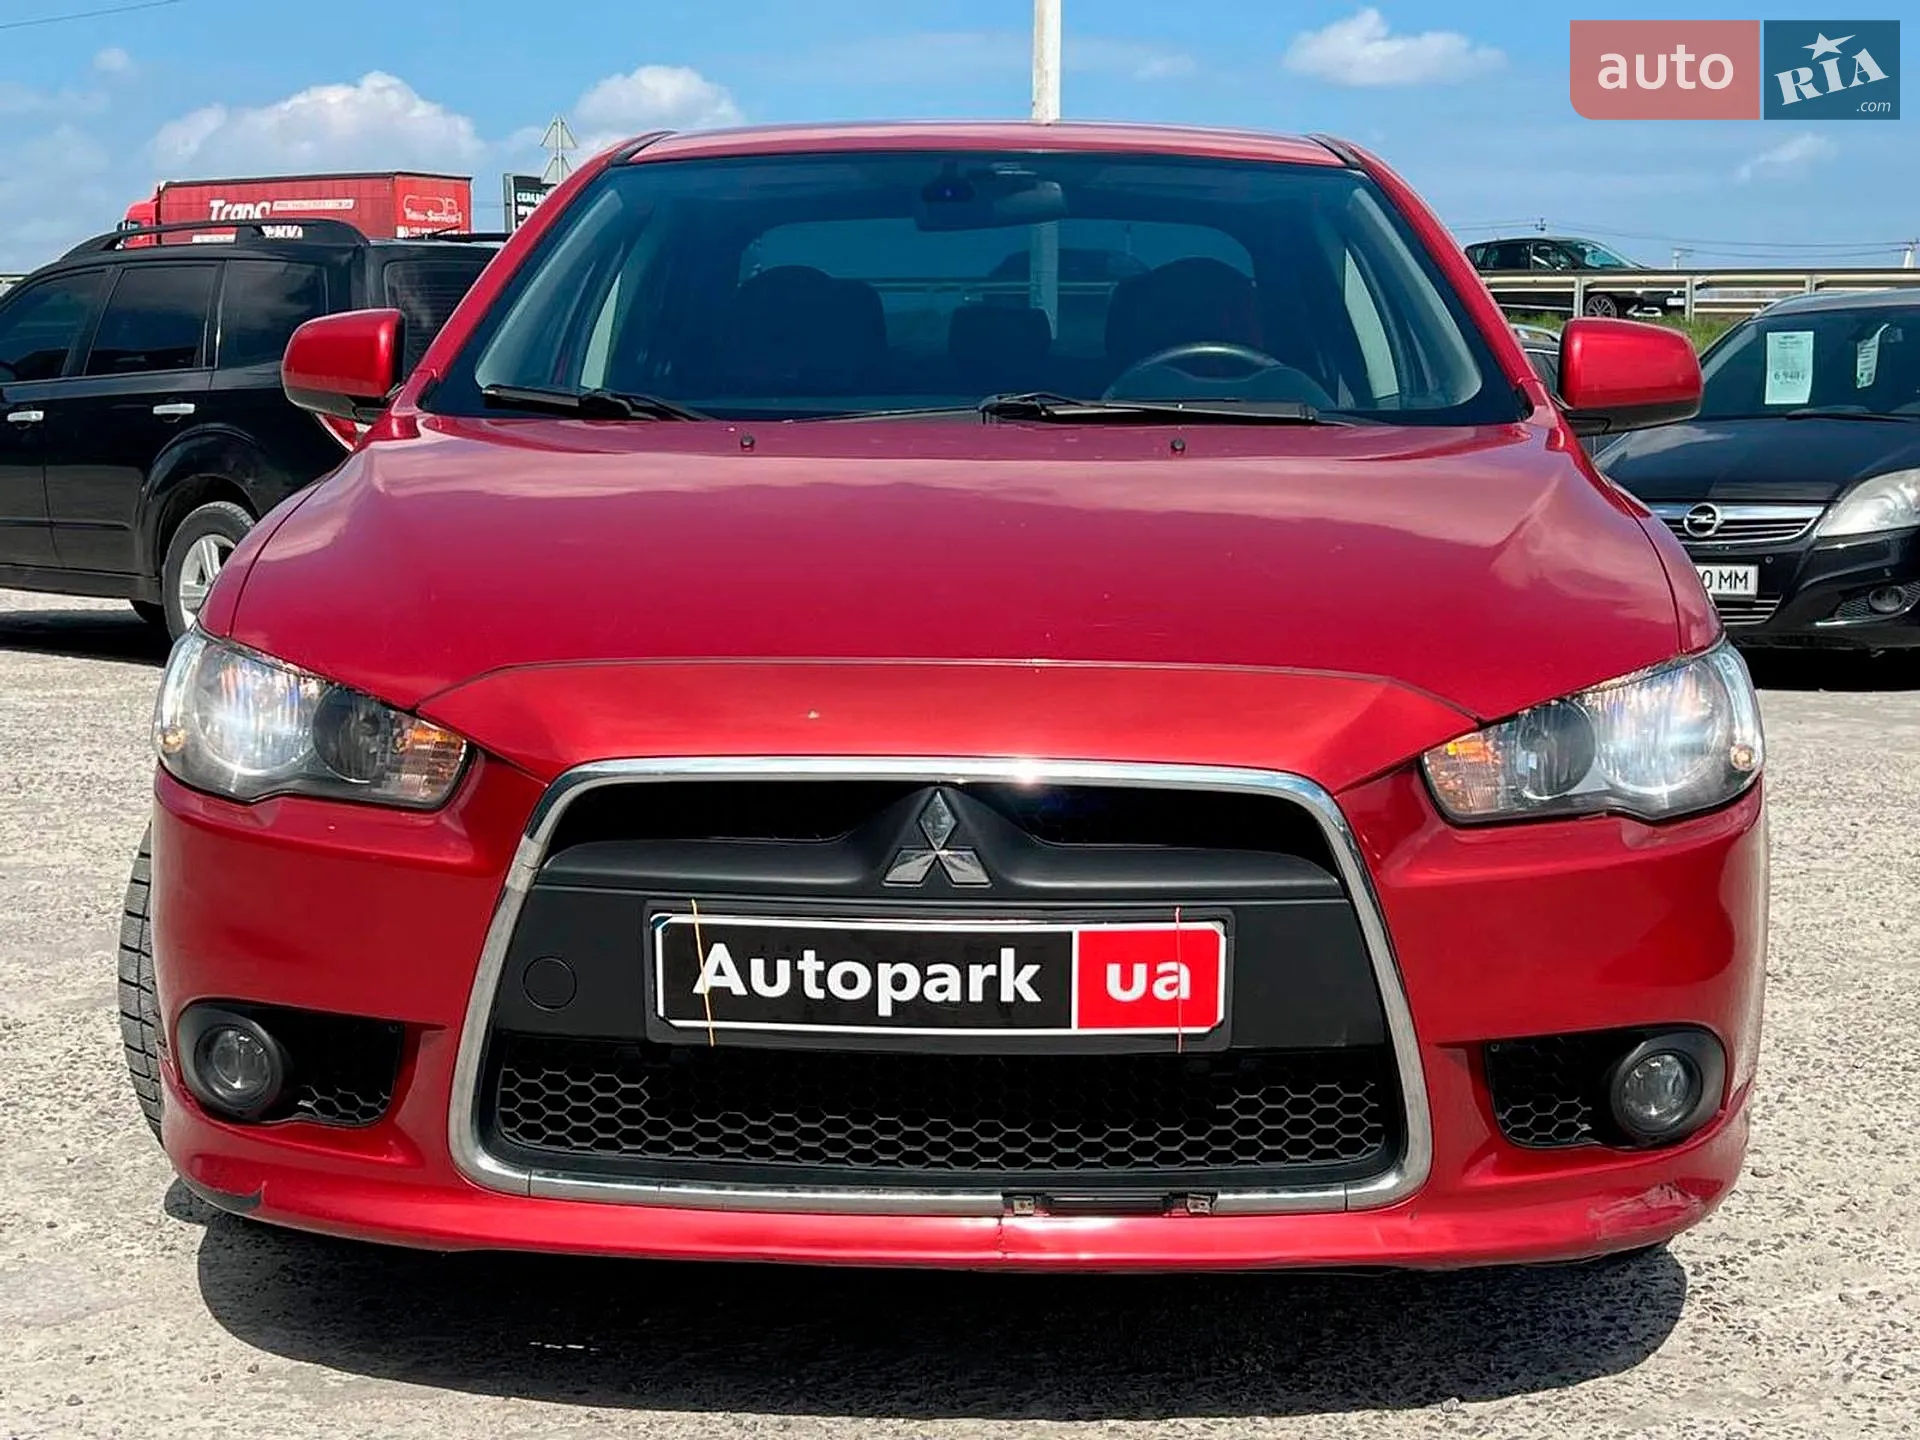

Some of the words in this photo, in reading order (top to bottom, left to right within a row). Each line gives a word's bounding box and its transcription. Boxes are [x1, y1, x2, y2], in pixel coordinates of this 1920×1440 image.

[1719, 569, 1748, 590] MM
[692, 943, 1042, 1016] Autopark
[1106, 960, 1192, 1002] ua
